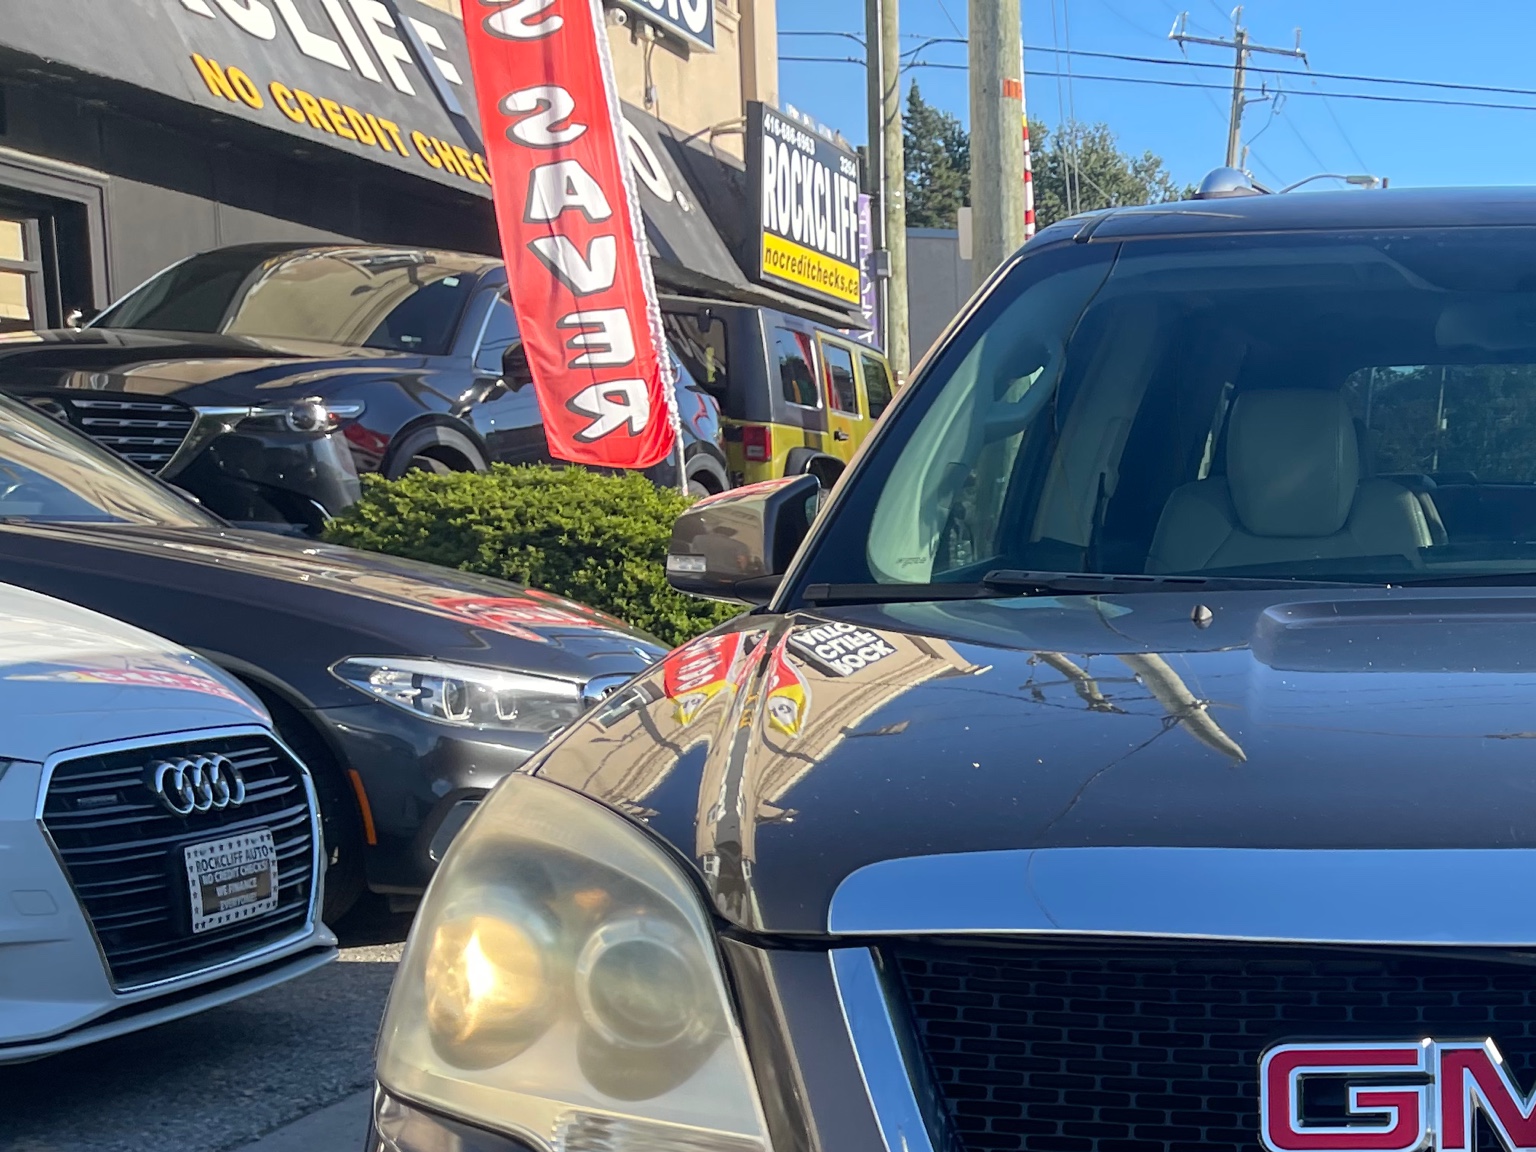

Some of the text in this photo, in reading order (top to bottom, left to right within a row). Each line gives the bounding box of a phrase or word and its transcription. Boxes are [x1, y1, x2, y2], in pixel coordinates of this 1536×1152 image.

[191, 53, 264, 109] NO
[269, 81, 410, 157] CREDIT
[763, 134, 858, 263] ROCKCLIFF
[765, 245, 859, 297] nocreditchecks.ca
[245, 844, 269, 861] AUTO
